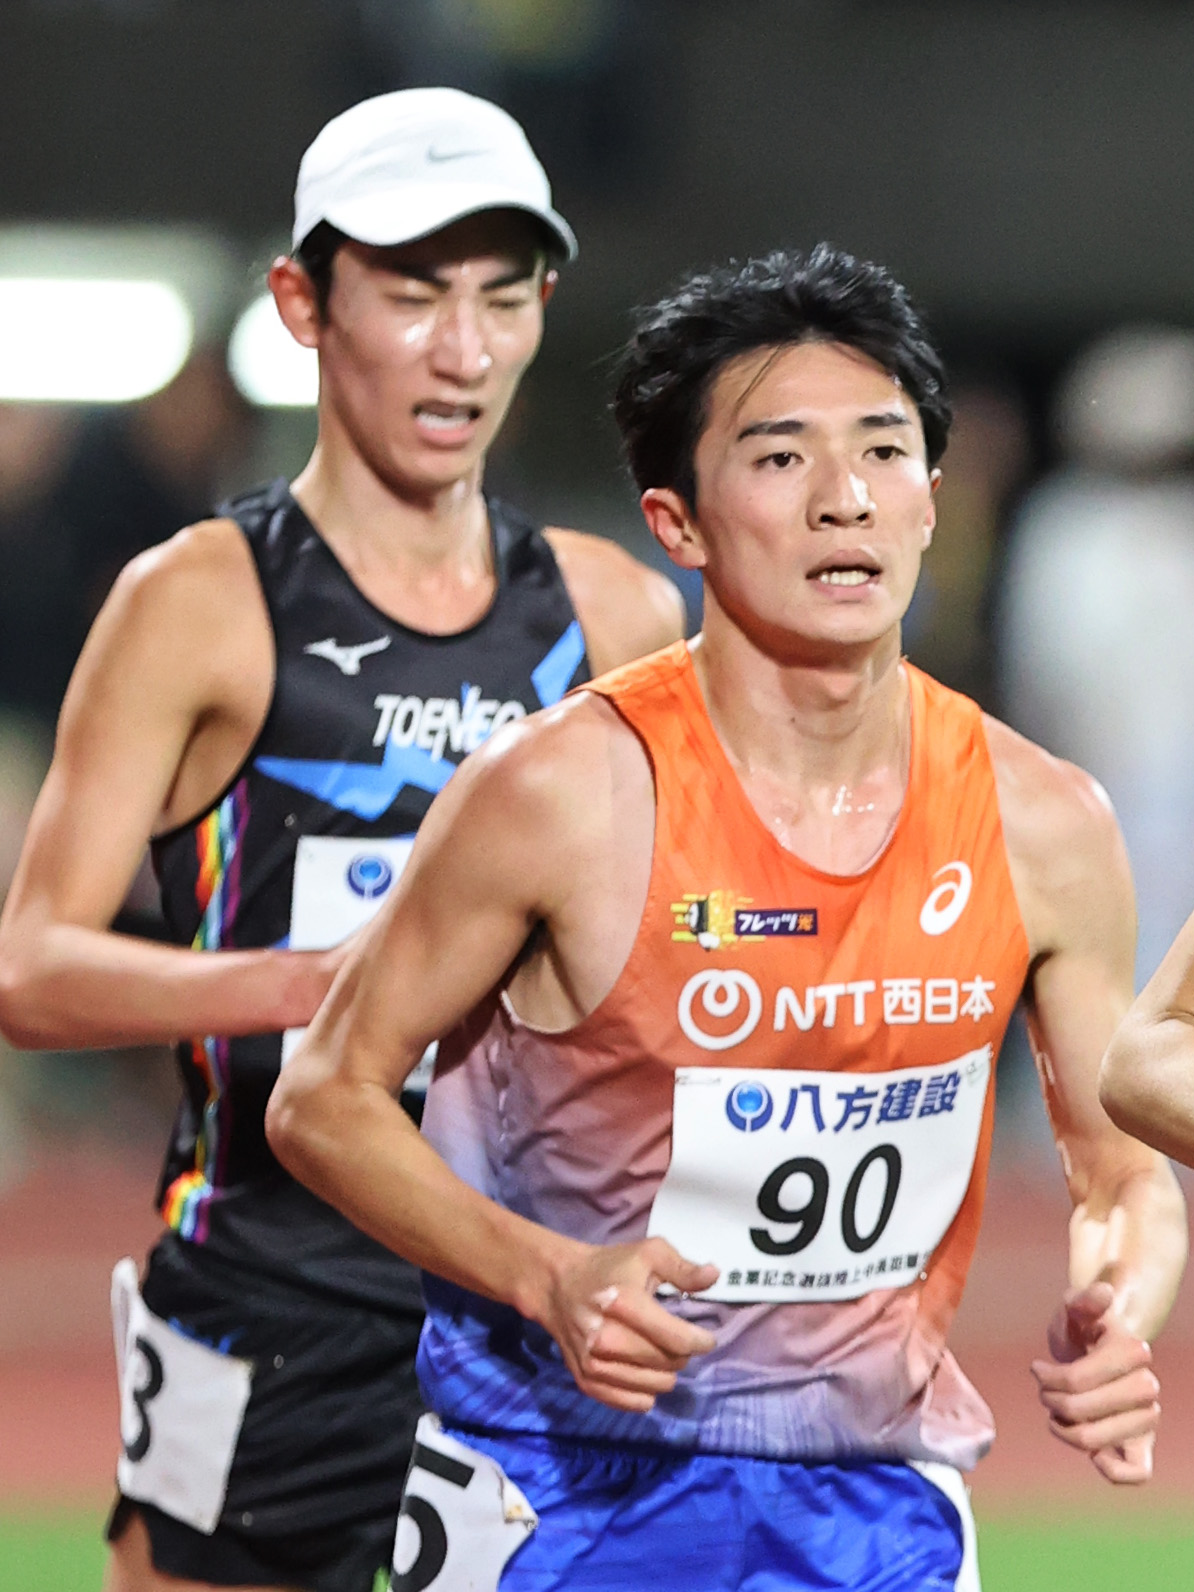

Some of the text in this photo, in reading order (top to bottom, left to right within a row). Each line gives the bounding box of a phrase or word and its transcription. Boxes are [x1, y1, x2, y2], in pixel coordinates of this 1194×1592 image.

[780, 1071, 960, 1133] 八方建設
[749, 1143, 901, 1256] 90
